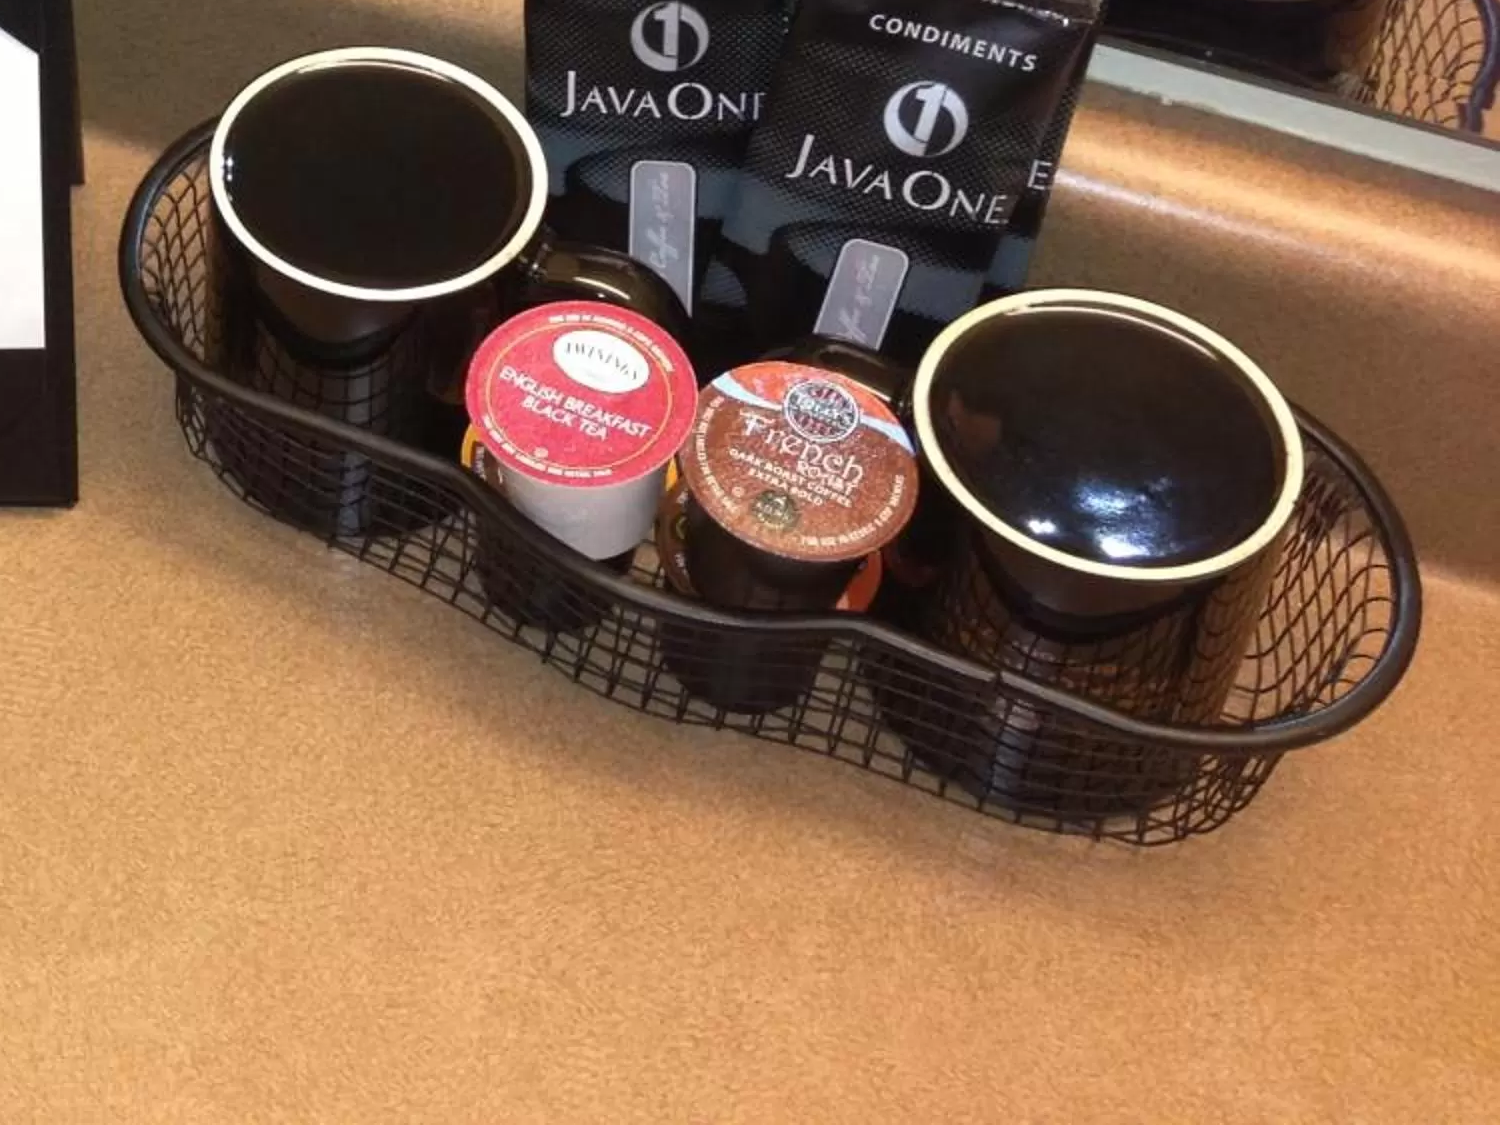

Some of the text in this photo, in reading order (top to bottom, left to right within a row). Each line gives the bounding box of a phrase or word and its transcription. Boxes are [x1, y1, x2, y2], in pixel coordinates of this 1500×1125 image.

[869, 12, 1038, 72] CONDIMENTS
[499, 365, 564, 405] ENGLISH
[564, 396, 653, 438] BREAKFAST
[521, 395, 609, 440] BLACK TEA
[740, 412, 864, 482] French
